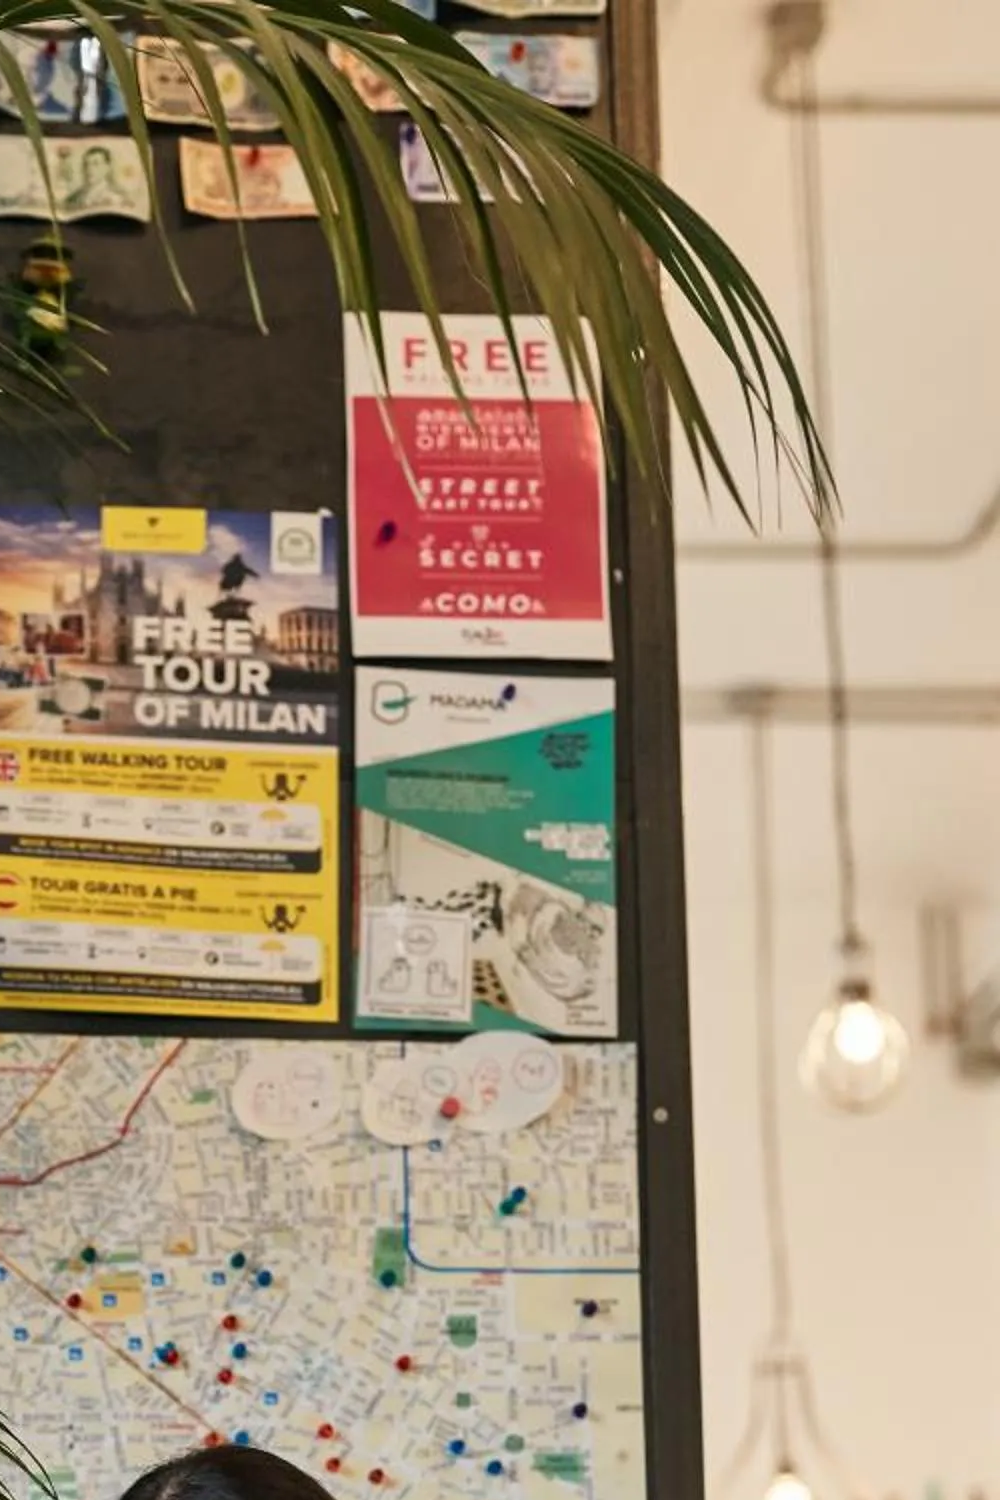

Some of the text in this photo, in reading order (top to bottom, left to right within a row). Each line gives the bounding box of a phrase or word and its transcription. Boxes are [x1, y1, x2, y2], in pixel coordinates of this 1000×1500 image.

[404, 338, 549, 372] FREE
[419, 549, 543, 569] SECRET
[436, 592, 531, 614] COMO
[133, 616, 253, 654] FREE
[134, 656, 271, 696] TOUR
[134, 696, 327, 735] OF MILAN
[28, 748, 228, 772] FREE WALKING TOUR
[30, 877, 198, 901] TOUR GRATIS A PIE
